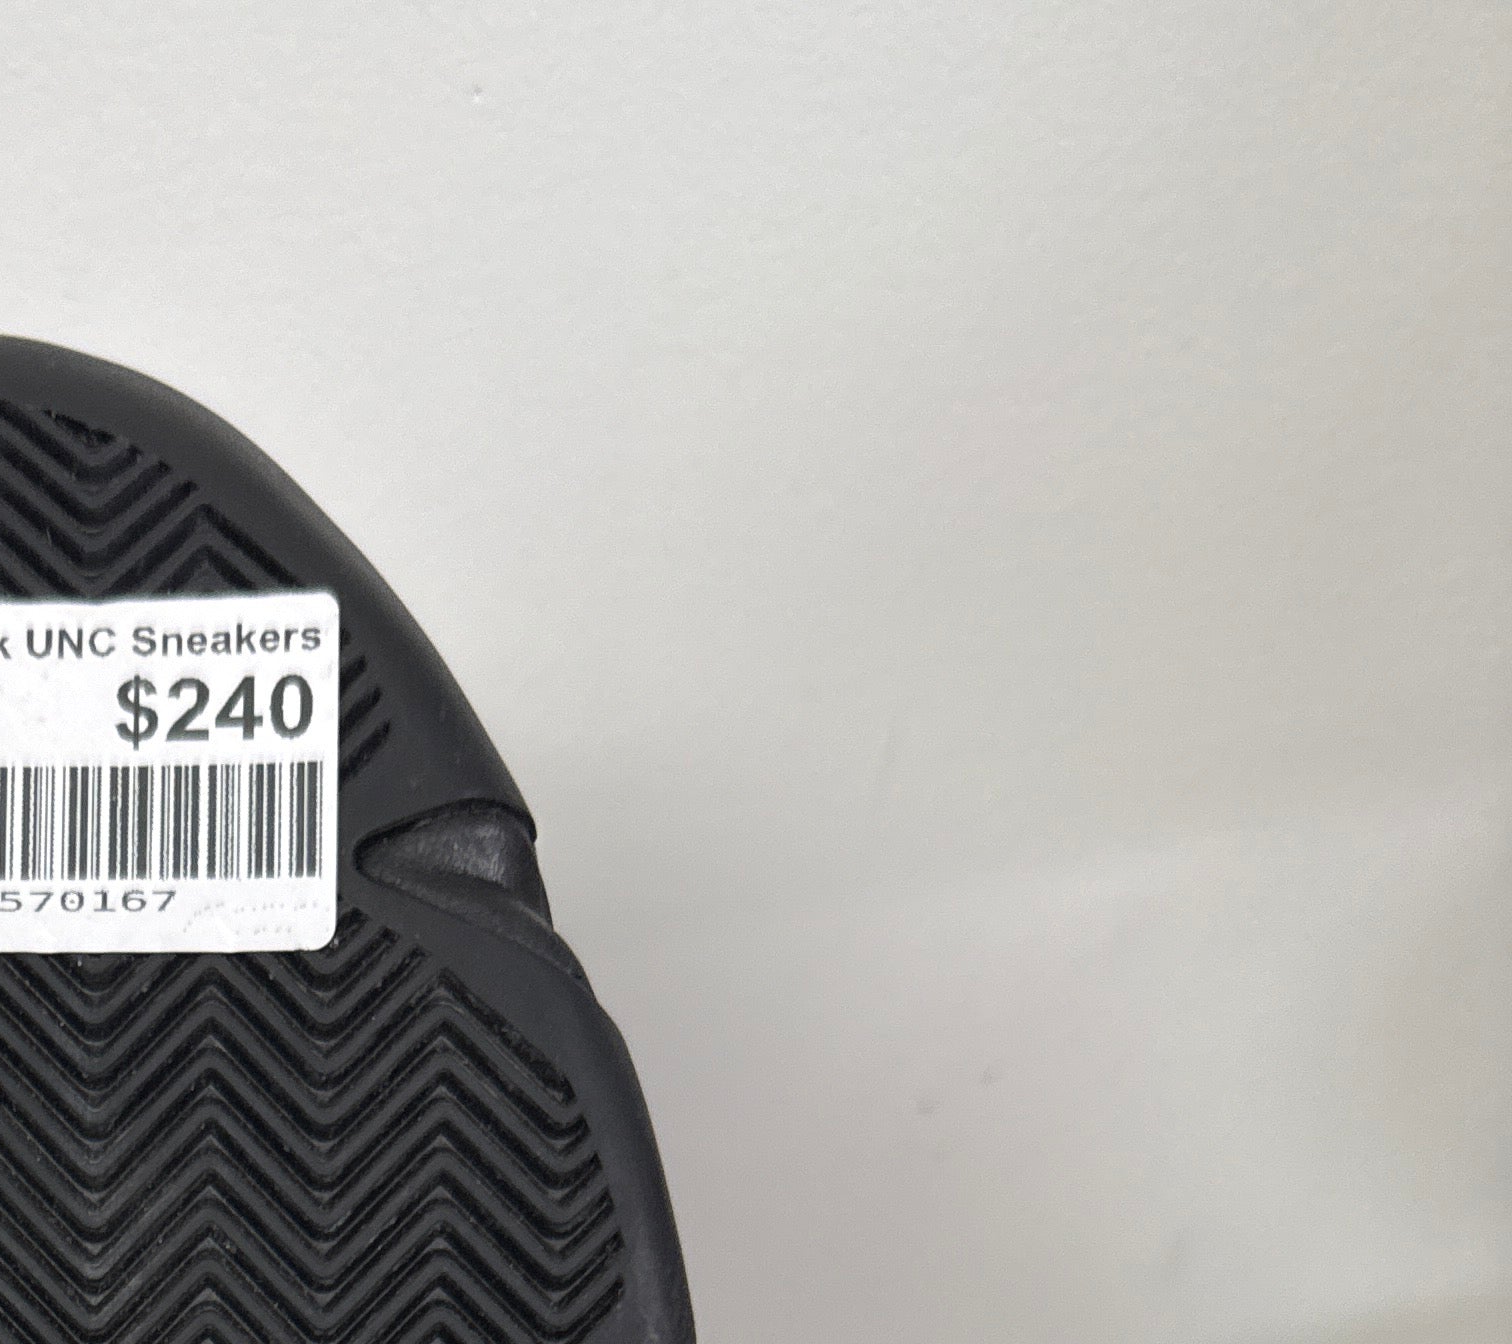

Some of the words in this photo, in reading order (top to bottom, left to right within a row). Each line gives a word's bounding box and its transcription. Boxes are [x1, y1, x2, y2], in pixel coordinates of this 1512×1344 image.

[25, 627, 116, 658] UNC
[132, 623, 322, 657] Sneakers
[116, 673, 314, 749] $240
